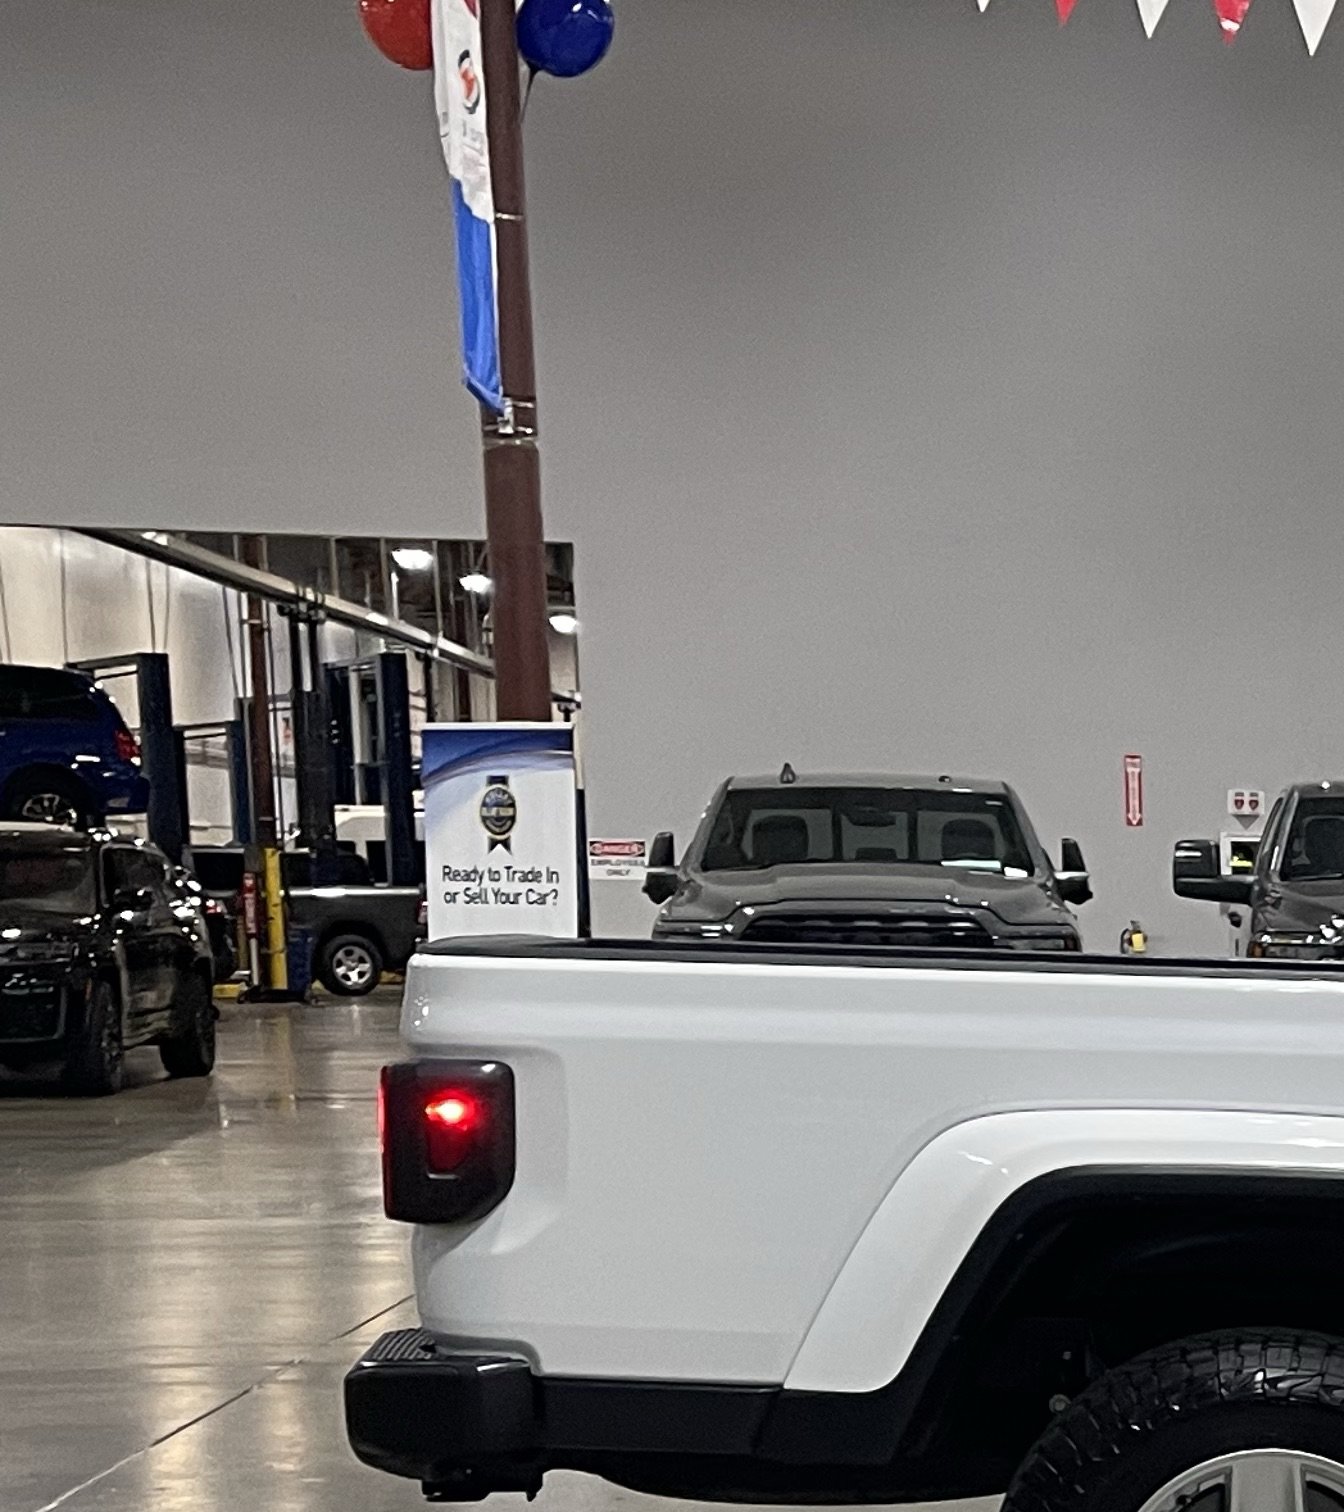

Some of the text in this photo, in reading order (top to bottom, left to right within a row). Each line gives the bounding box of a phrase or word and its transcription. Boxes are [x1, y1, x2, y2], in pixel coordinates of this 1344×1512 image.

[442, 865, 560, 886] Ready to Trade In
[444, 887, 558, 906] or Sell Your Car?
